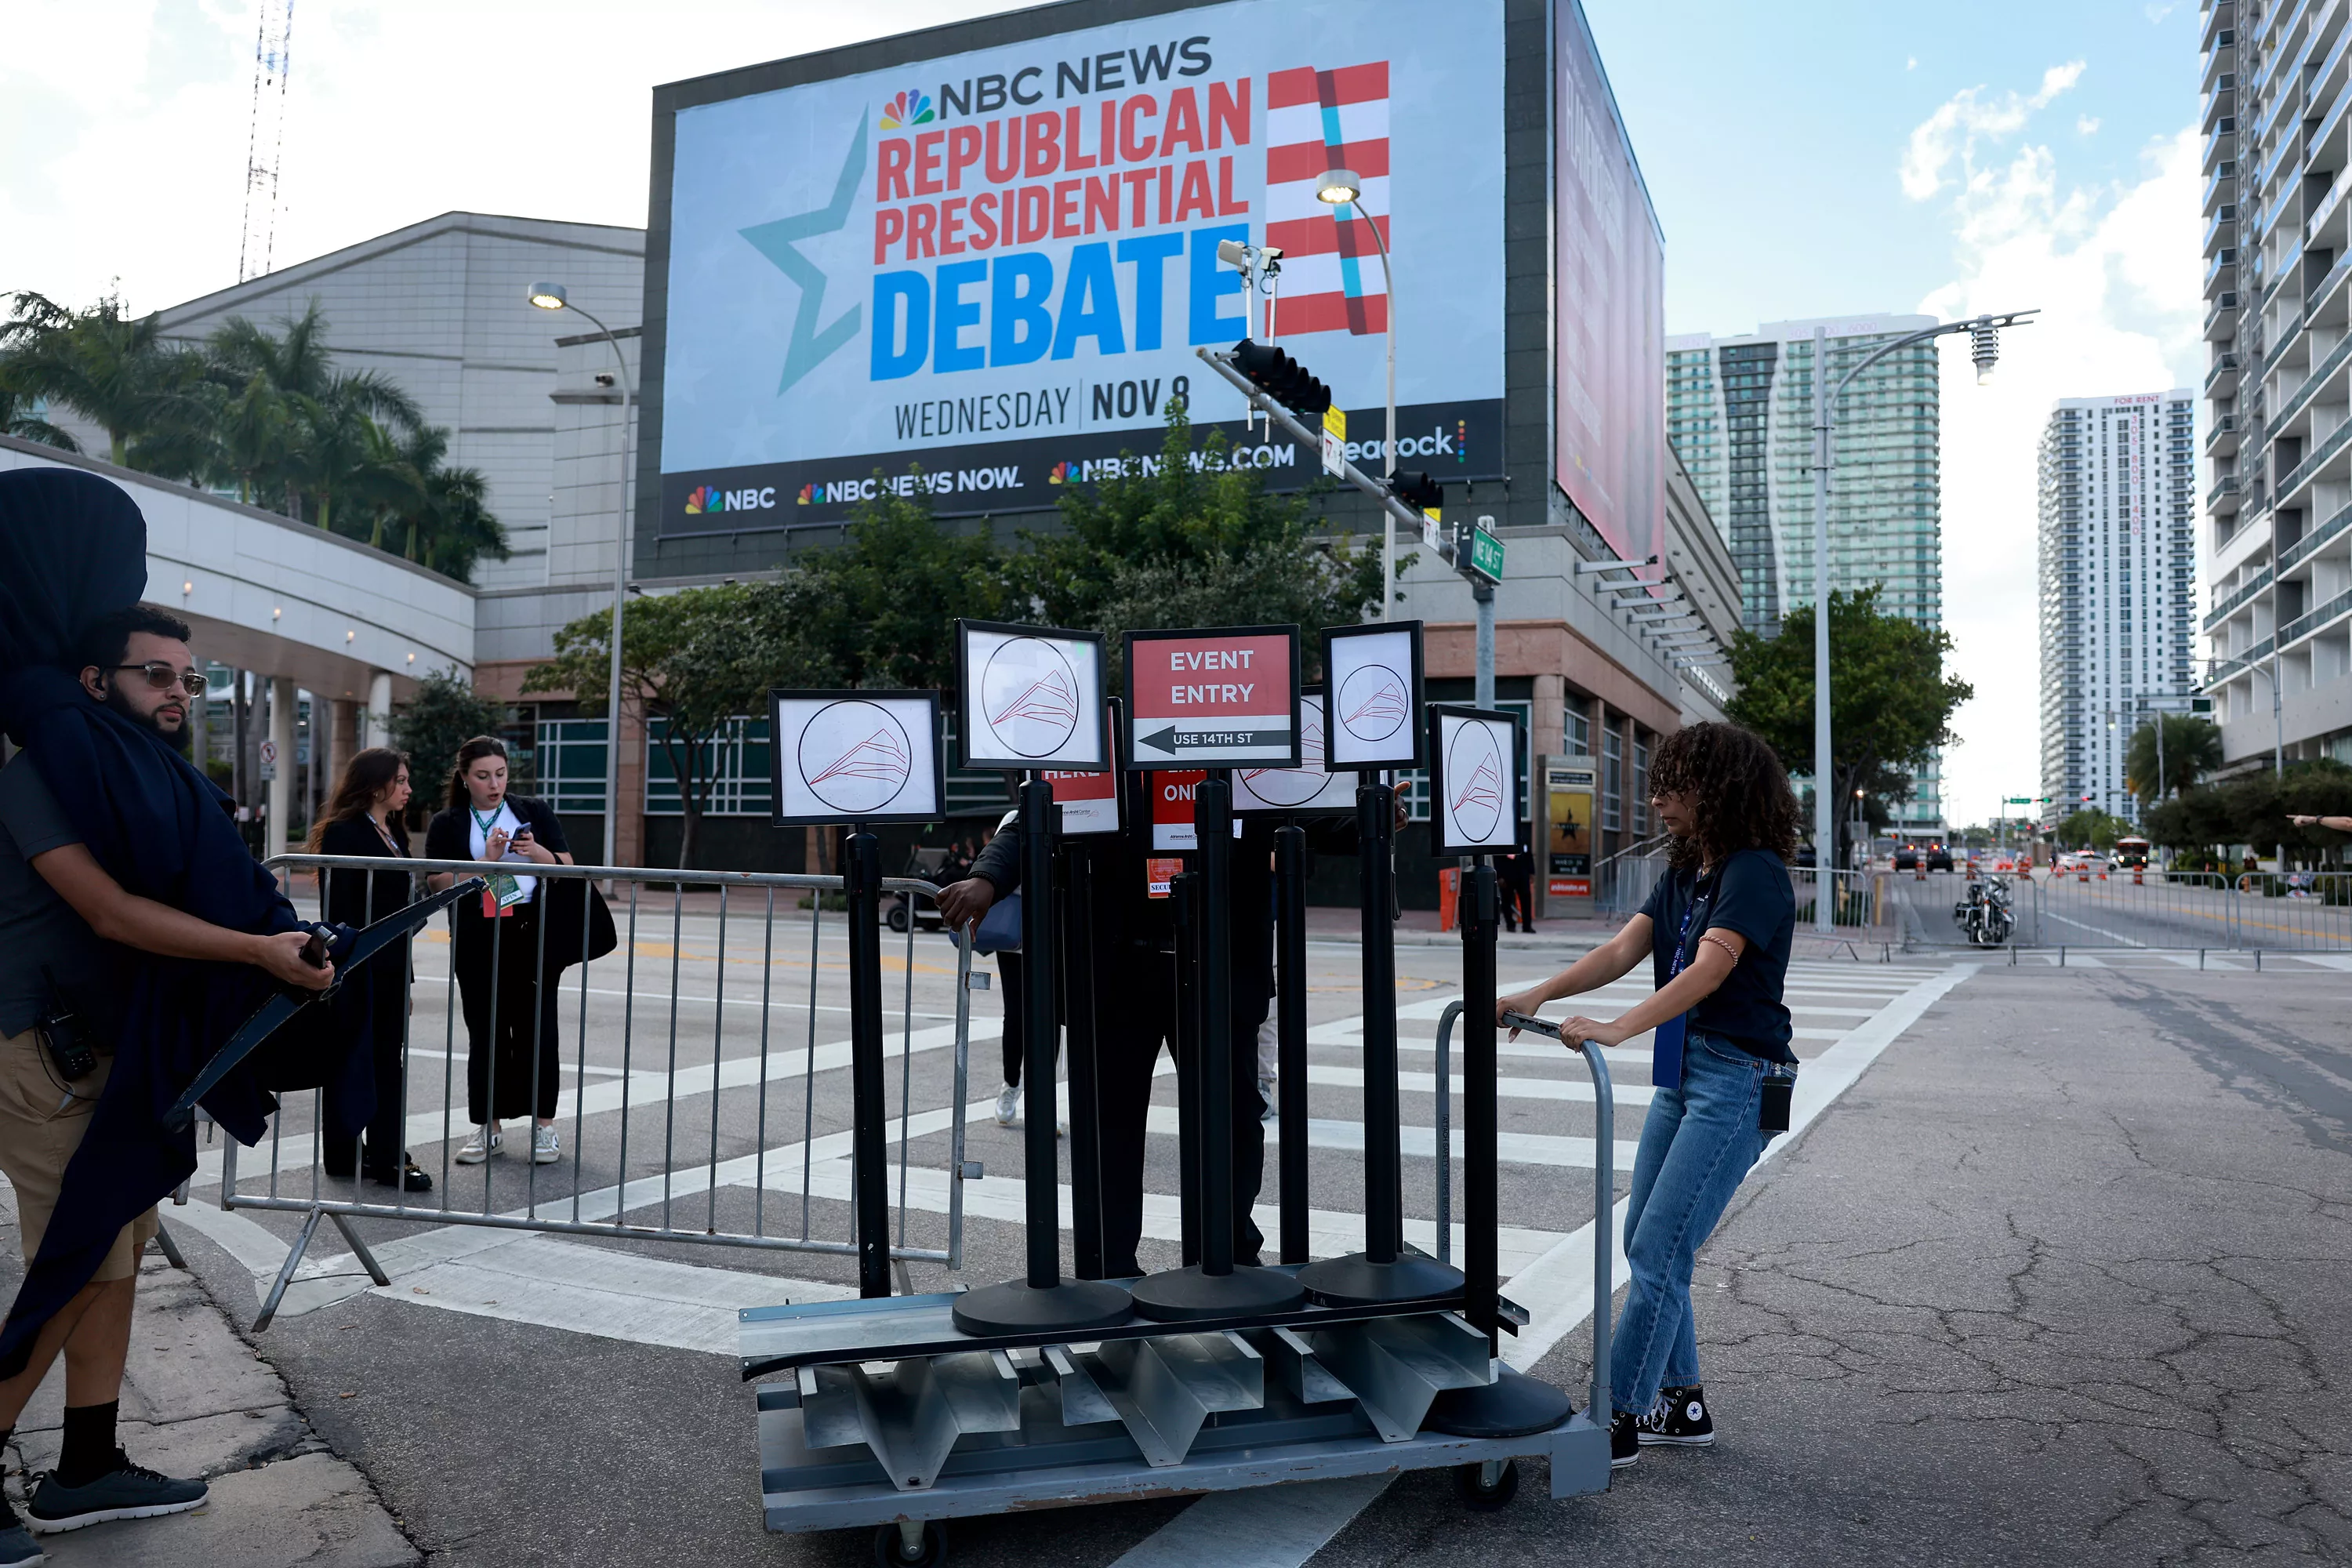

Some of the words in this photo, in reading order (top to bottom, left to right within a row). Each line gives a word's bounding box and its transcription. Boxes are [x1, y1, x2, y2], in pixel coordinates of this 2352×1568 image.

[940, 67, 1044, 120] NBC
[1056, 36, 1213, 99] NEWS
[877, 77, 1251, 203] REPUBLICAN
[874, 155, 1249, 265] PRESIDENTIAL
[870, 223, 1249, 381] DEBATE
[895, 387, 1071, 440] WEDNESDAY
[1092, 379, 1160, 421] NOV
[1173, 376, 1189, 412] 8
[2114, 397, 2133, 405] FOR
[2136, 395, 2161, 405] RENT
[1082, 443, 1294, 483] NBCNWS.COM
[1323, 426, 1454, 475] eaock
[724, 487, 776, 512] NBC
[826, 477, 877, 503] NBC
[881, 471, 953, 499] NEWS
[1475, 539, 1486, 562] NE
[1493, 550, 1501, 572] ST
[1171, 650, 1254, 671] EVENT
[1171, 684, 1254, 704] ENTRY
[1173, 734, 1199, 745] USE
[1202, 733, 1233, 744] 14TH
[1237, 733, 1253, 743] ST
[1044, 770, 1100, 780] HE
[502, 893, 518, 903] SPIN
